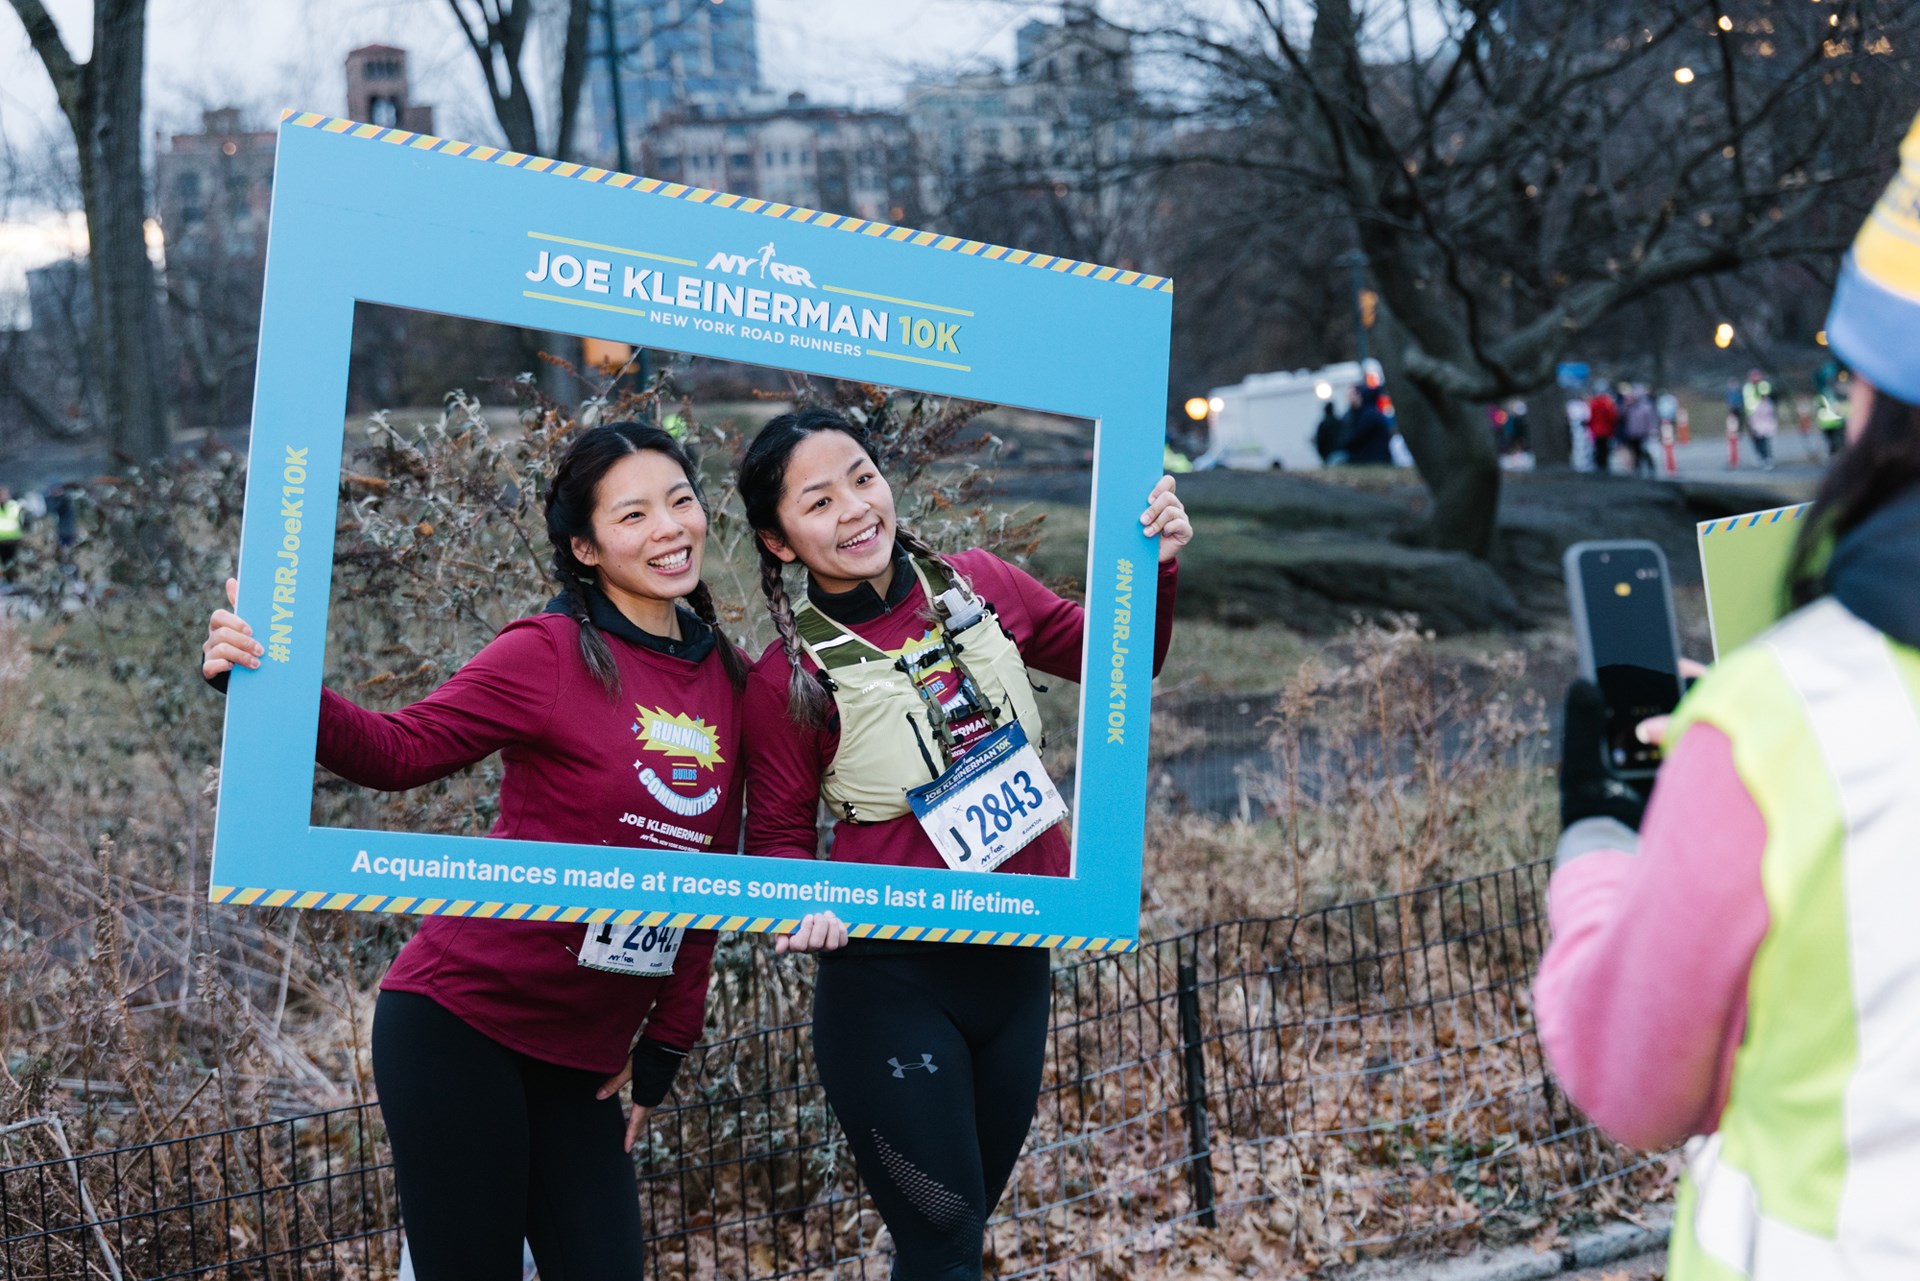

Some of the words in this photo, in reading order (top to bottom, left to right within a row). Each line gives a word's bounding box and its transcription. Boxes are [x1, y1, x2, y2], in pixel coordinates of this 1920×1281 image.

[525, 250, 612, 295] JOE
[623, 266, 890, 343] KLEINERMAN
[898, 316, 962, 354] 10K
[650, 310, 683, 328] NEW
[685, 318, 736, 338] YORK
[740, 326, 785, 345] ROAD
[789, 334, 863, 358] RUNNERS
[267, 445, 309, 663] #NYRRJoeK10K
[1107, 558, 1134, 745] #NYRRJoeK10K
[651, 720, 711, 755] RUNNING
[638, 767, 719, 816] COMMUNITIES
[672, 769, 697, 780] BUILDS
[924, 787, 942, 803] JOE
[942, 748, 998, 791] KLEINERMAN
[995, 738, 1011, 755] 10K
[619, 812, 646, 828] JOE
[647, 819, 706, 843] KLEINERMAN
[965, 770, 1043, 847] 2843
[949, 826, 972, 862] J
[351, 850, 557, 884] Acquaintances
[563, 867, 635, 890] made
[641, 870, 666, 892] at
[672, 874, 741, 896] races
[747, 880, 879, 906] sometimes
[884, 885, 926, 909] last
[931, 893, 945, 909] a
[951, 889, 1041, 915] lifetime.
